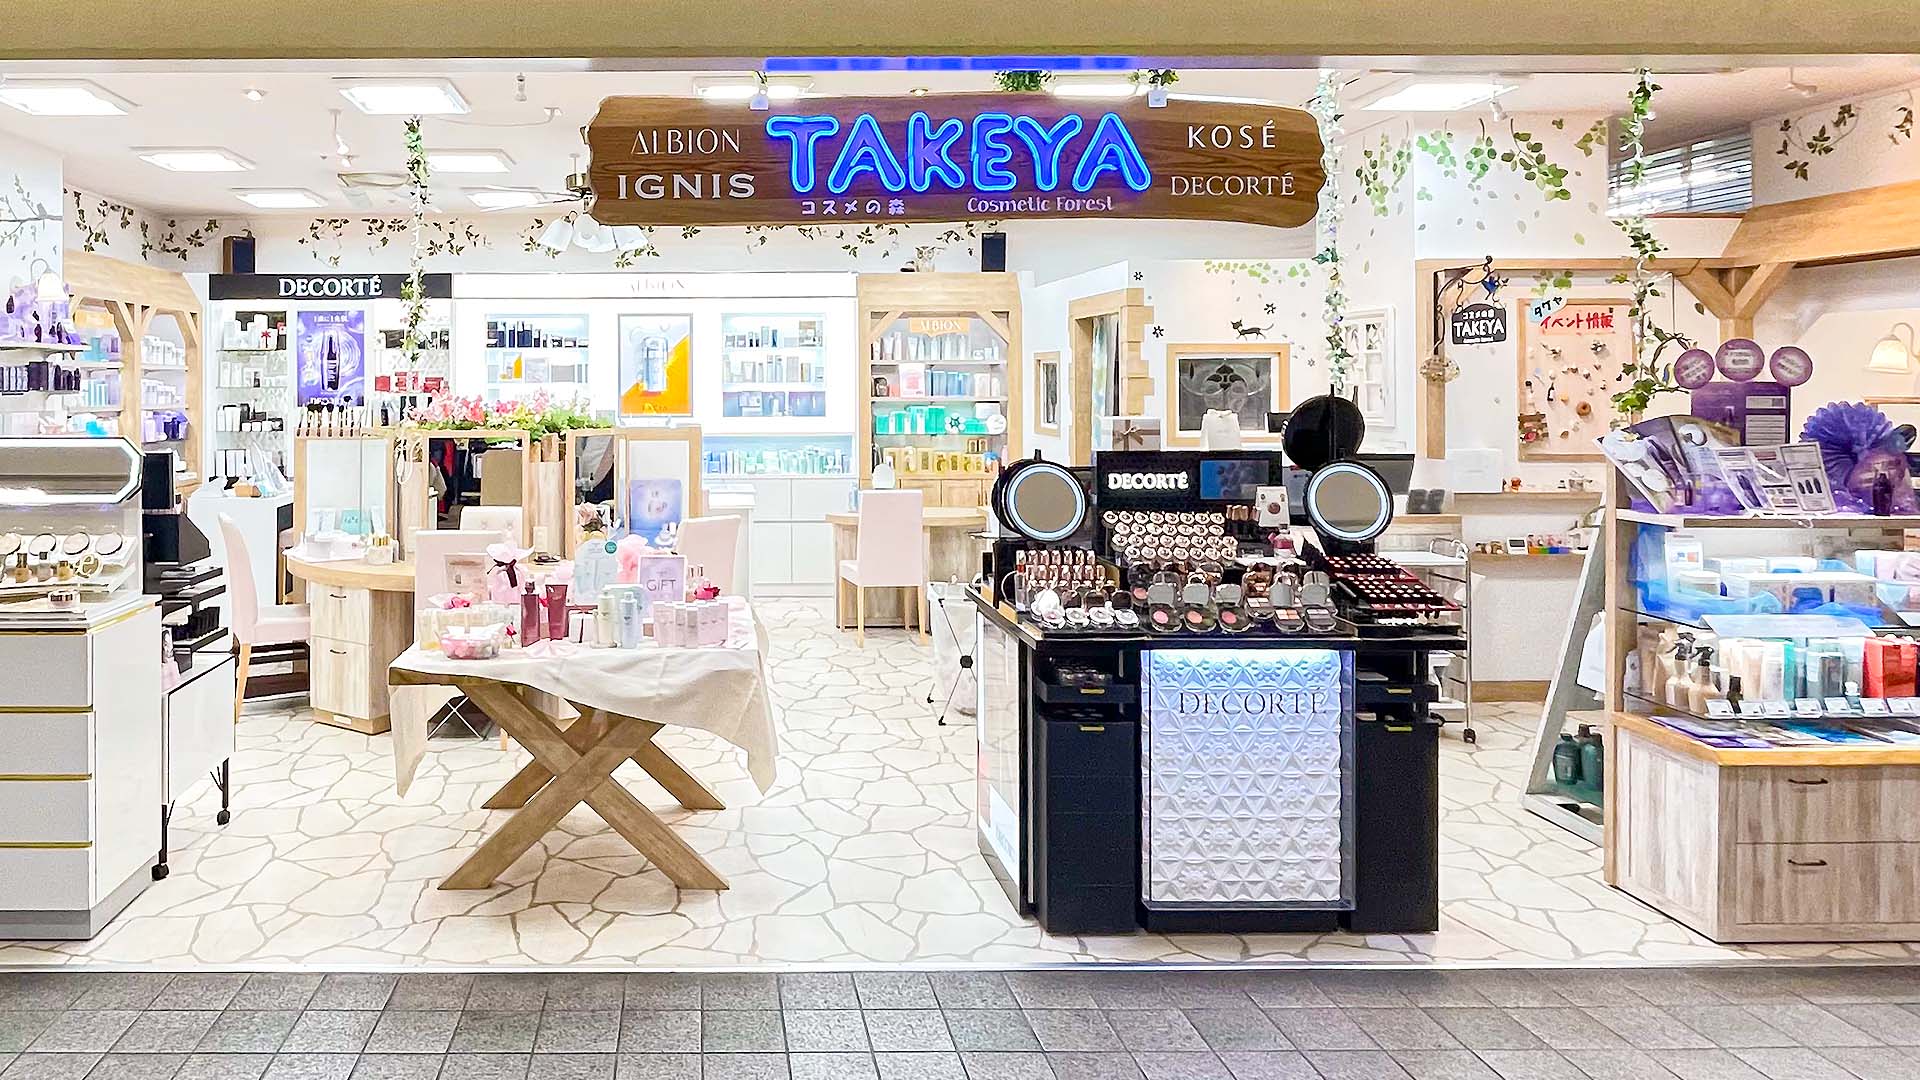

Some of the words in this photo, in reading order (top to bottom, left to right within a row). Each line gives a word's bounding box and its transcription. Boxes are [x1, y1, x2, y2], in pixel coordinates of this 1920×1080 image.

[631, 128, 741, 155] ALBION
[1187, 120, 1277, 149] KOSÉ
[766, 111, 1153, 195] TAKEYA
[618, 173, 755, 200] IGNIS
[1171, 172, 1296, 197] DECORTÉ
[801, 199, 906, 215] コスメの森
[967, 197, 1050, 213] Cosmetic
[1056, 196, 1114, 212] Forest
[279, 274, 383, 297] DECORTÉ
[1453, 317, 1505, 338] TAKEYA
[1108, 471, 1190, 490] DECORTÉ
[646, 579, 677, 592] GIFT
[1179, 686, 1328, 715] DECORTÉ
